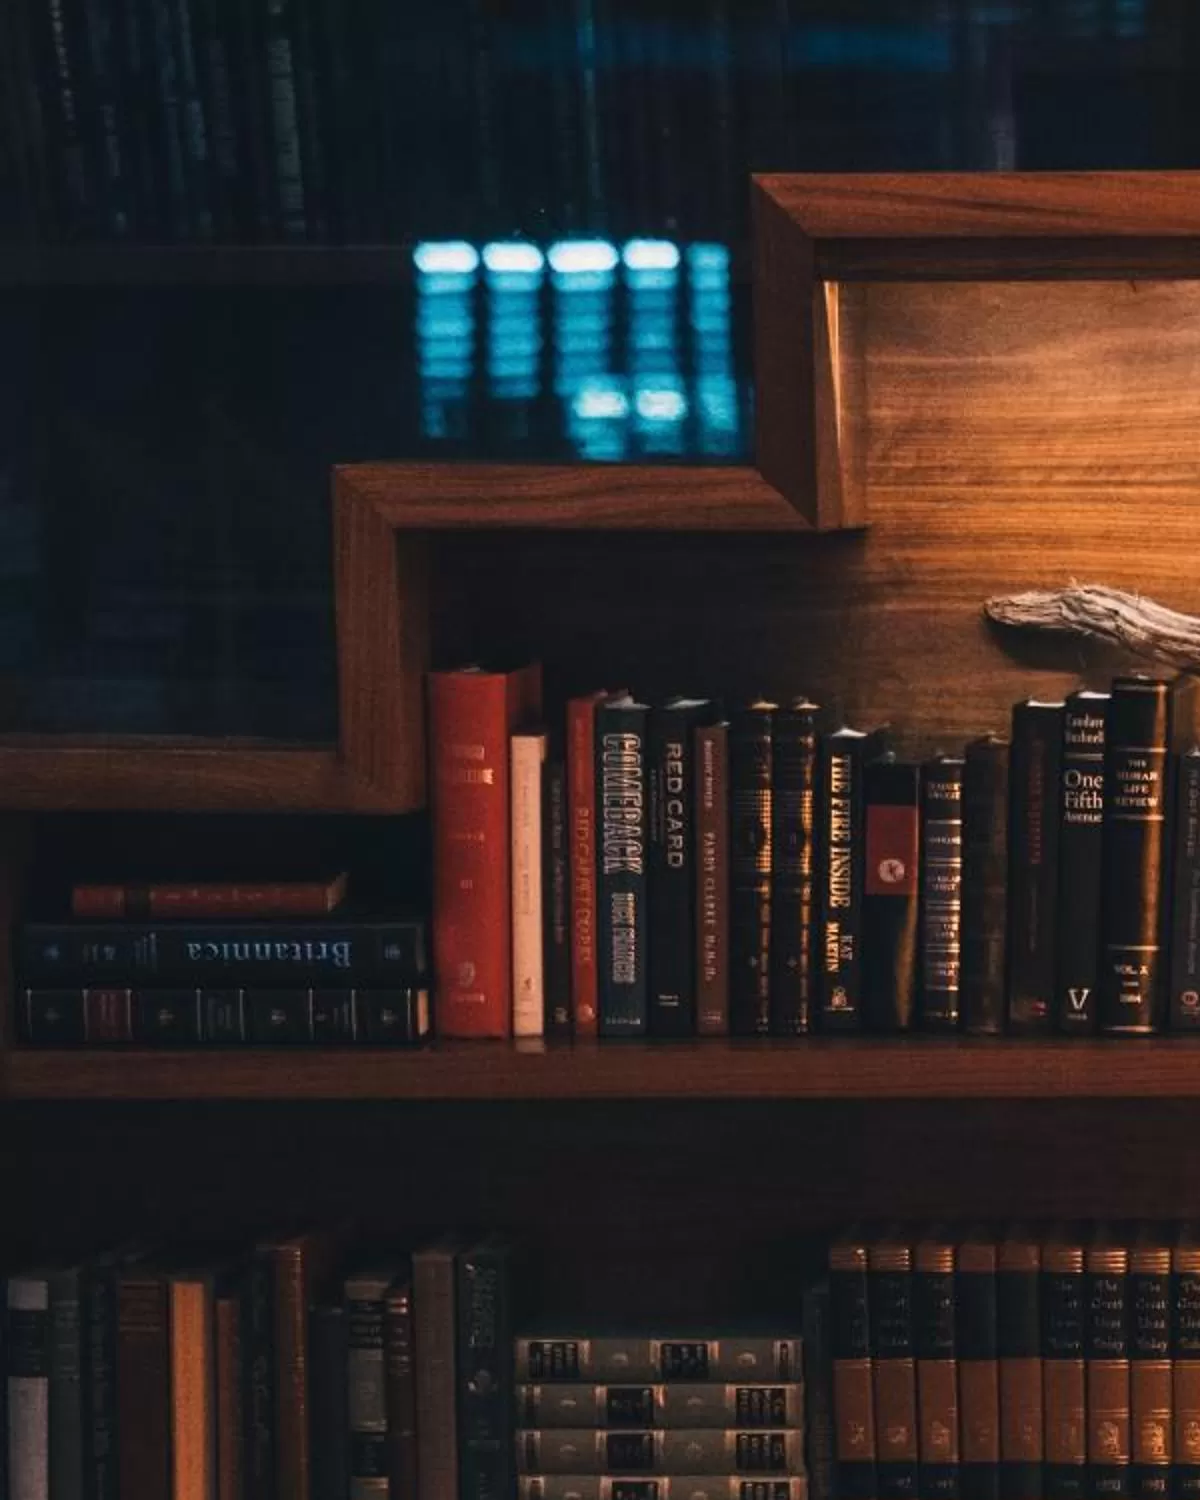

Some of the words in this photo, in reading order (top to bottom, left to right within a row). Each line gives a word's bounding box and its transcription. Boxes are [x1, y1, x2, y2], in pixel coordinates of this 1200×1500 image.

[666, 743, 683, 794] RED
[831, 755, 851, 793] THE
[1064, 769, 1103, 789] One
[602, 732, 643, 876] COMEBACK
[831, 797, 851, 841] FIRE
[1064, 790, 1103, 810] Fifth
[667, 800, 684, 868] CARD
[829, 846, 851, 908] INSIDE
[187, 940, 353, 969] Britannica
[825, 921, 840, 973] MARTIN
[840, 935, 854, 961] KAT
